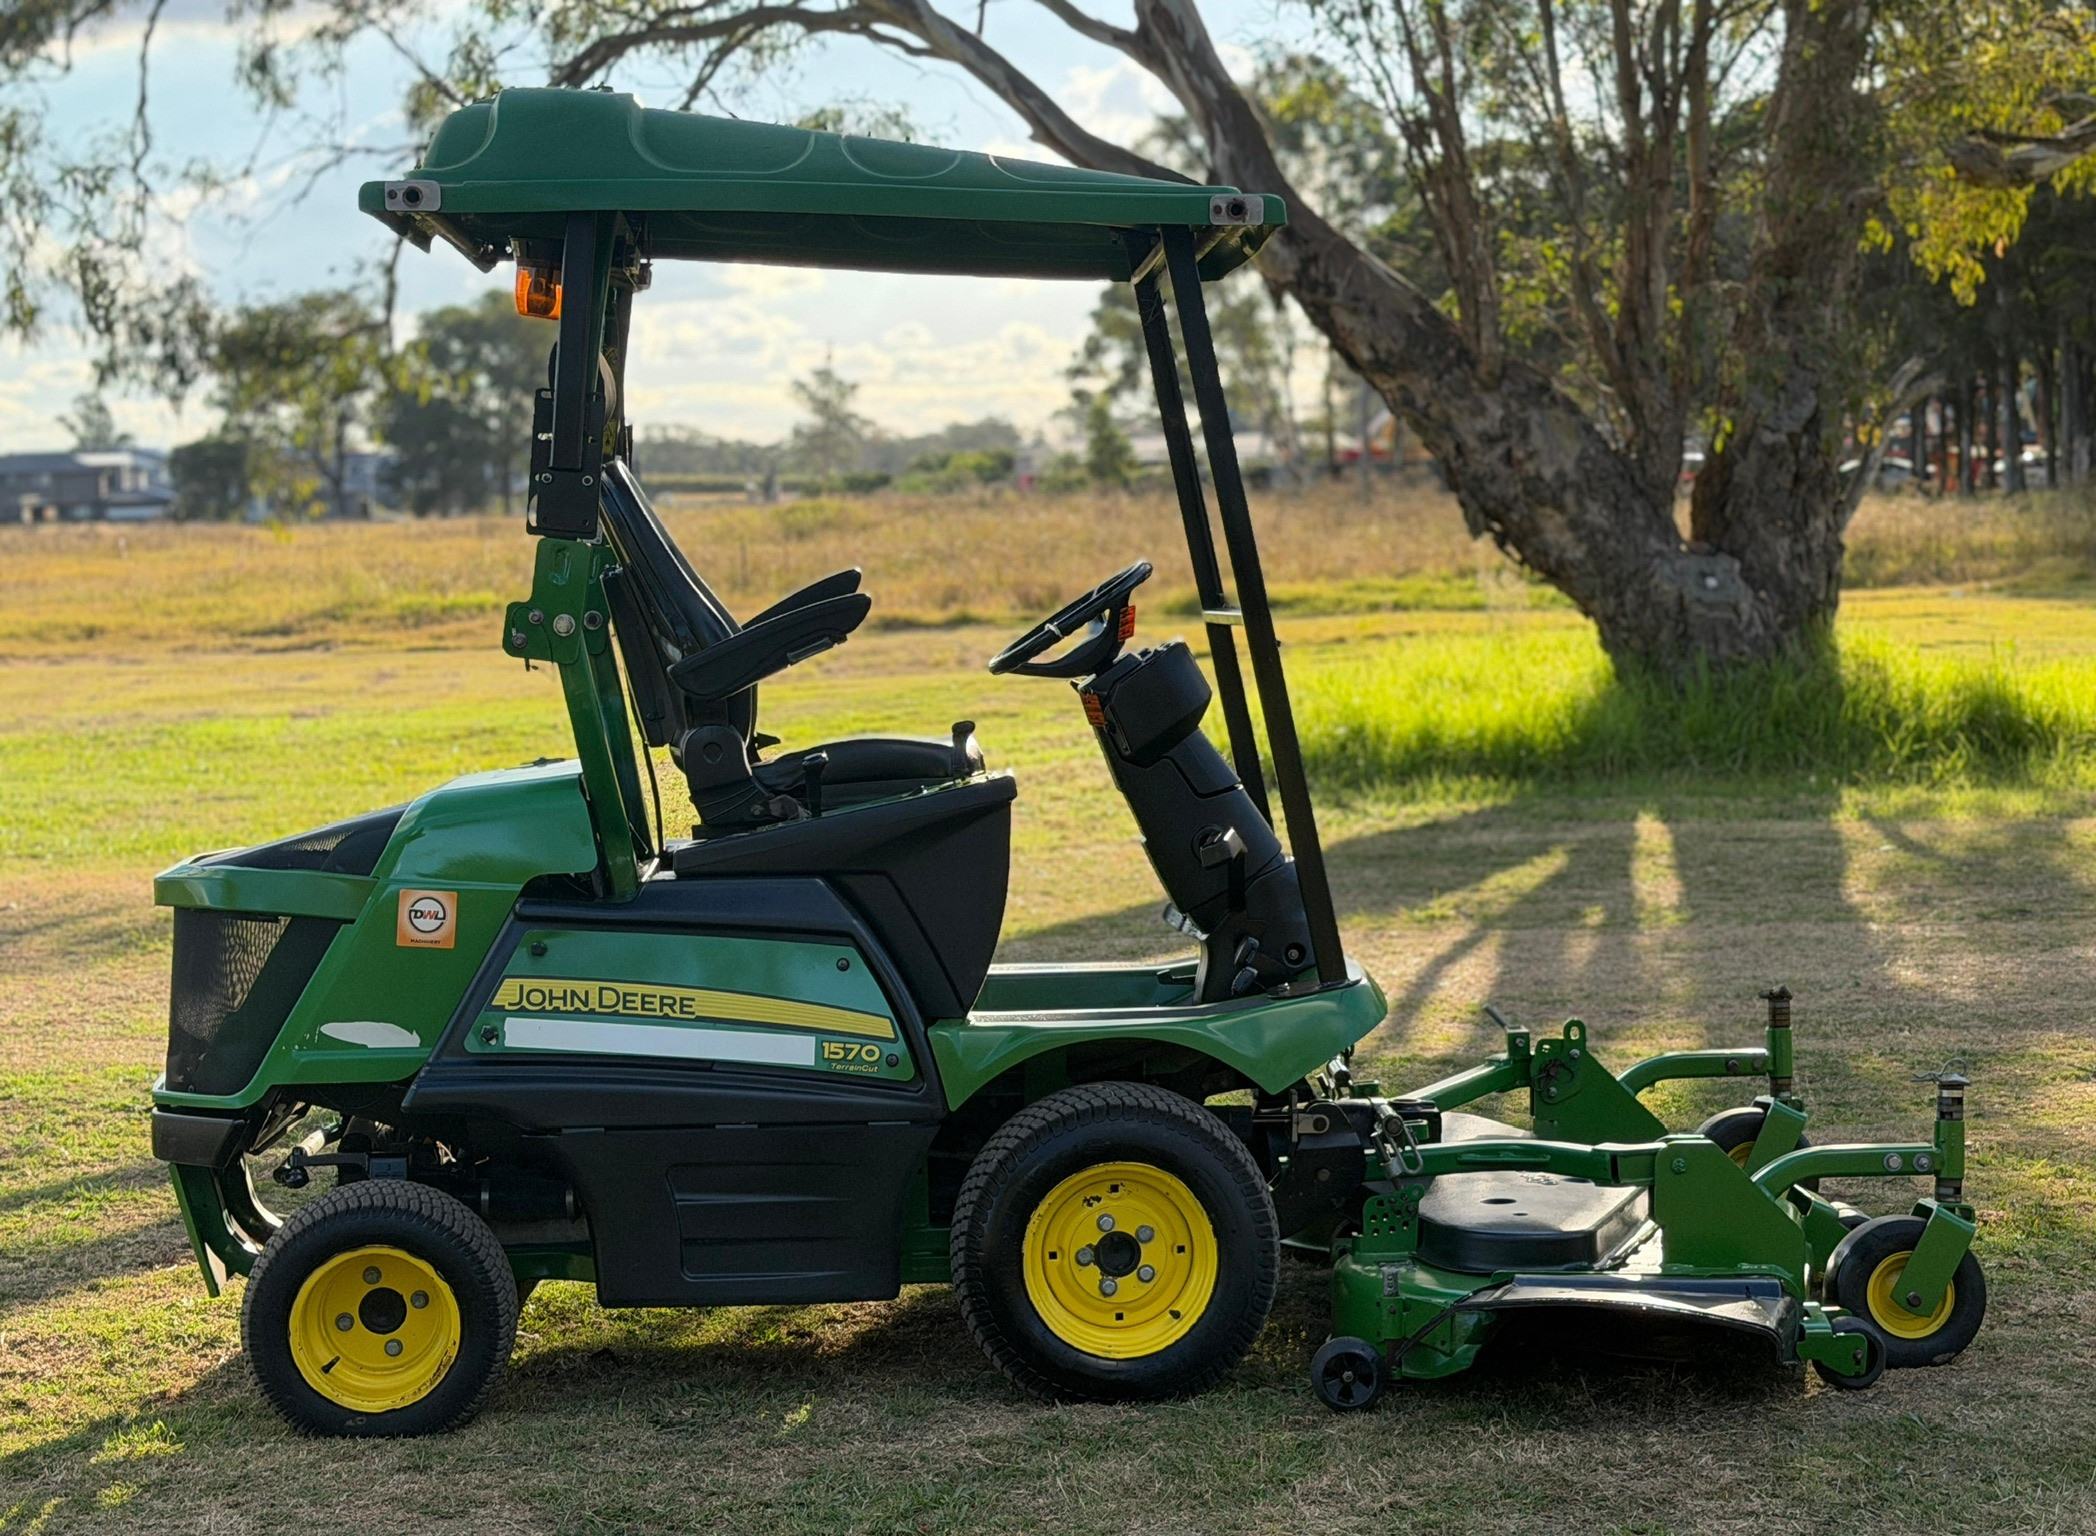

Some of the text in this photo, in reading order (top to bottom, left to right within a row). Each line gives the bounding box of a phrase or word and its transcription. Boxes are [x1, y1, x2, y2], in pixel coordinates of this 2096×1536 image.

[409, 909, 446, 921] DWL
[508, 984, 696, 1016] JOHN DEERE
[822, 1042, 881, 1062] 1570
[831, 1062, 879, 1073] TerrainCut
